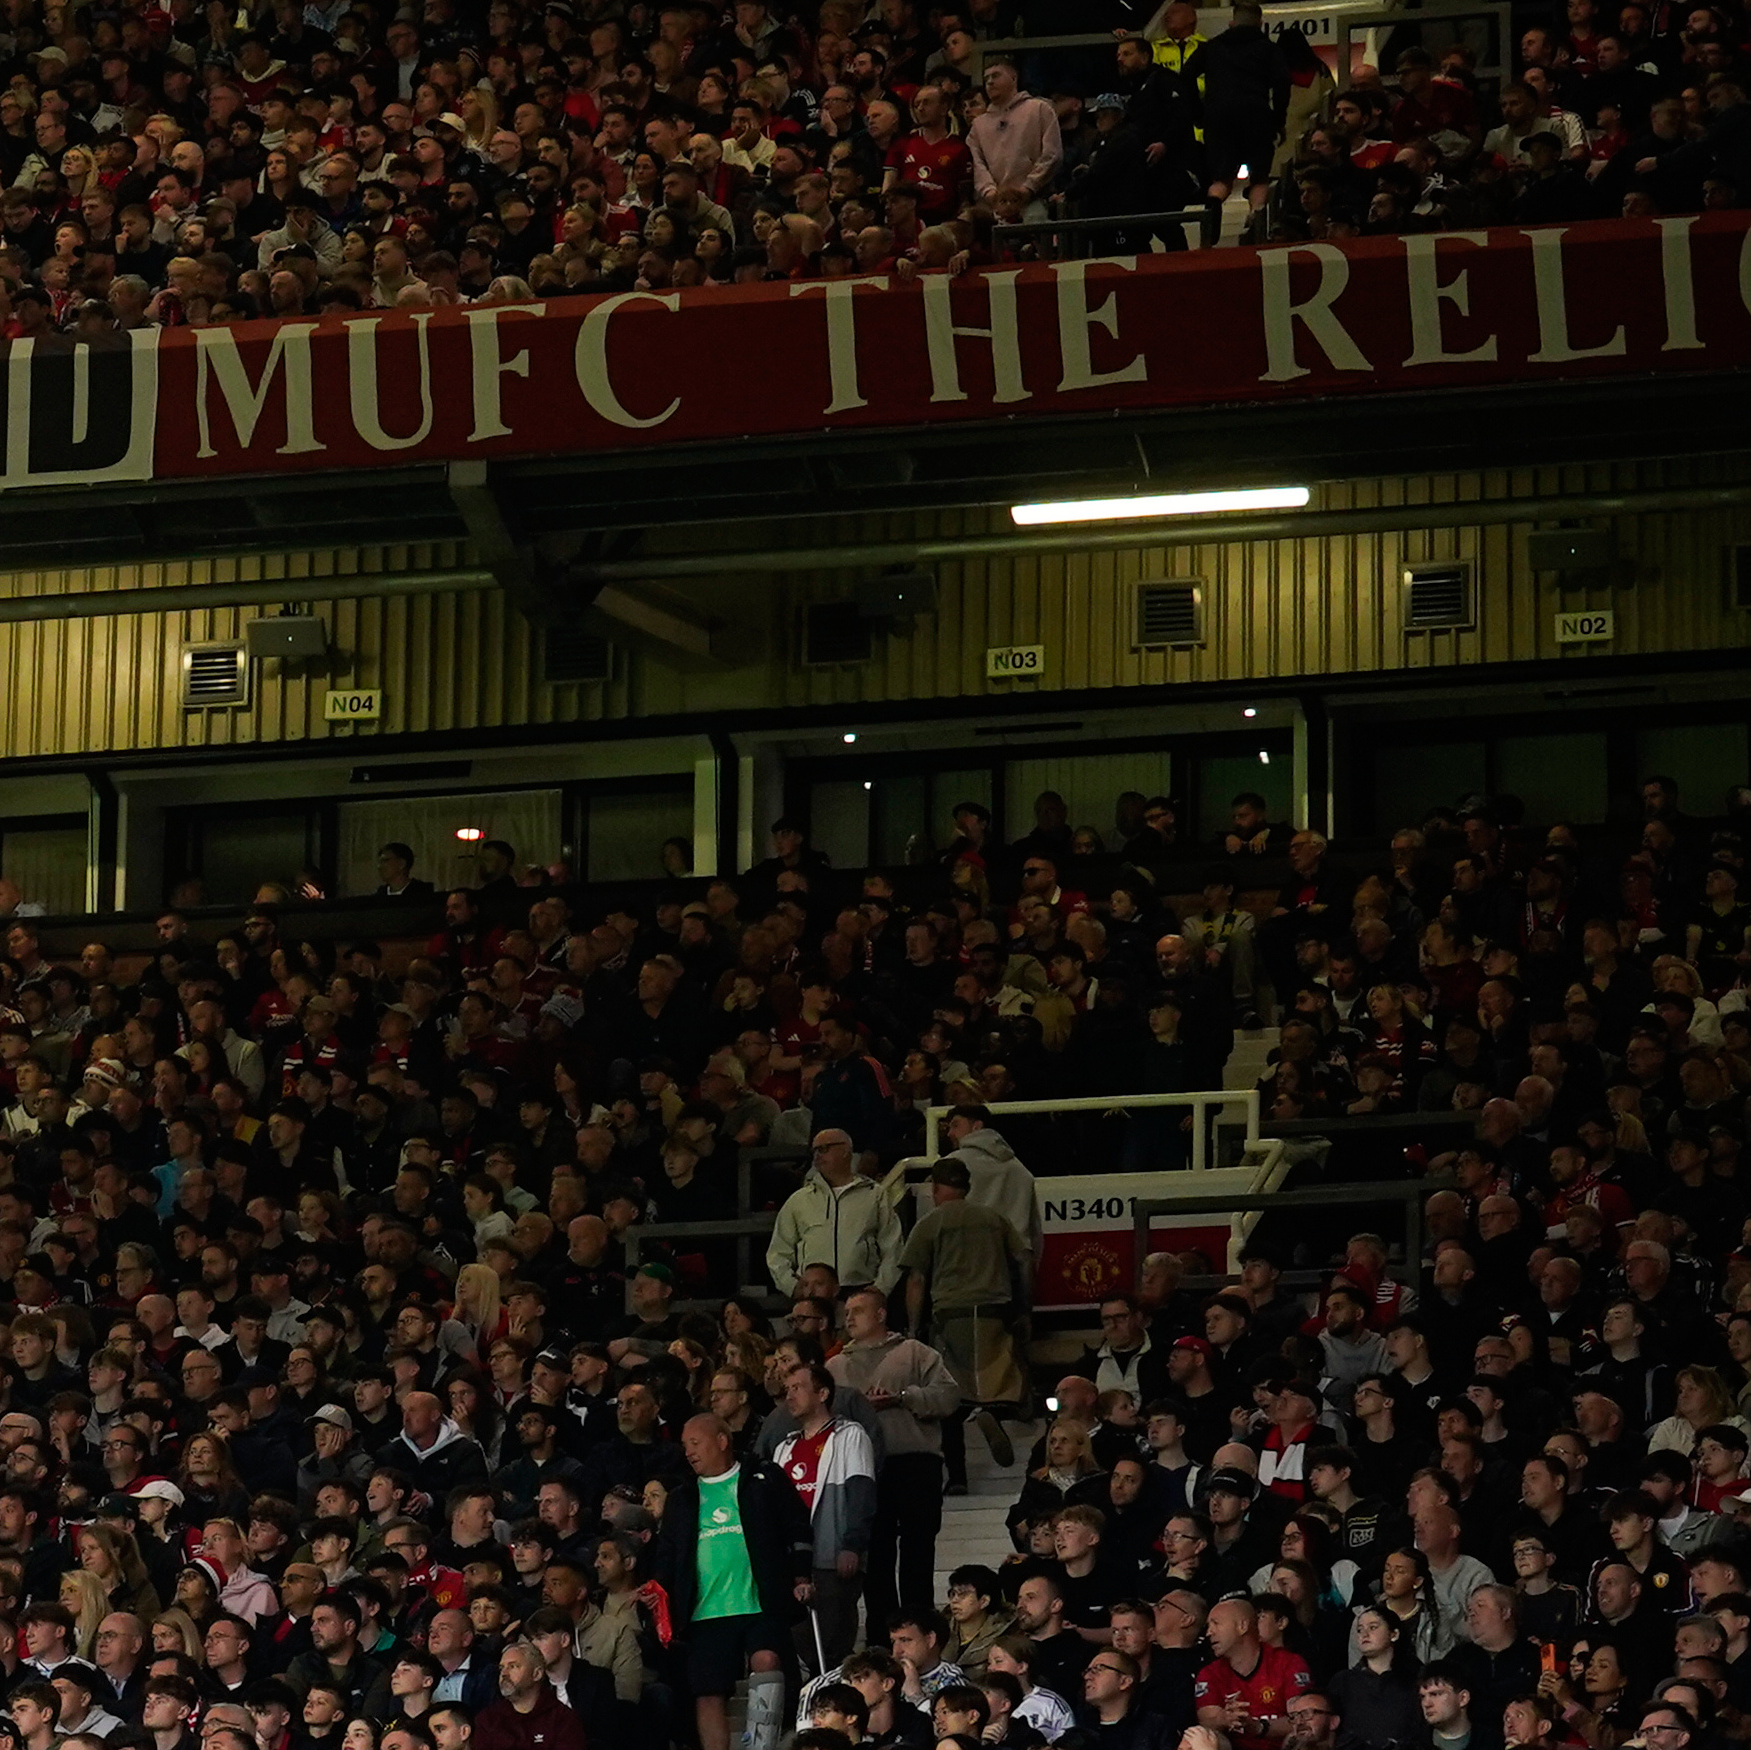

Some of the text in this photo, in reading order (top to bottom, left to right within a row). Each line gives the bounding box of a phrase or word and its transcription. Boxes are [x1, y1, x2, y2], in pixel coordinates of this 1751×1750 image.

[191, 216, 1751, 458] MUFC THE RELI
[1562, 617, 1607, 636] N02
[332, 695, 374, 713] N04
[1044, 1197, 1138, 1221] N3401
